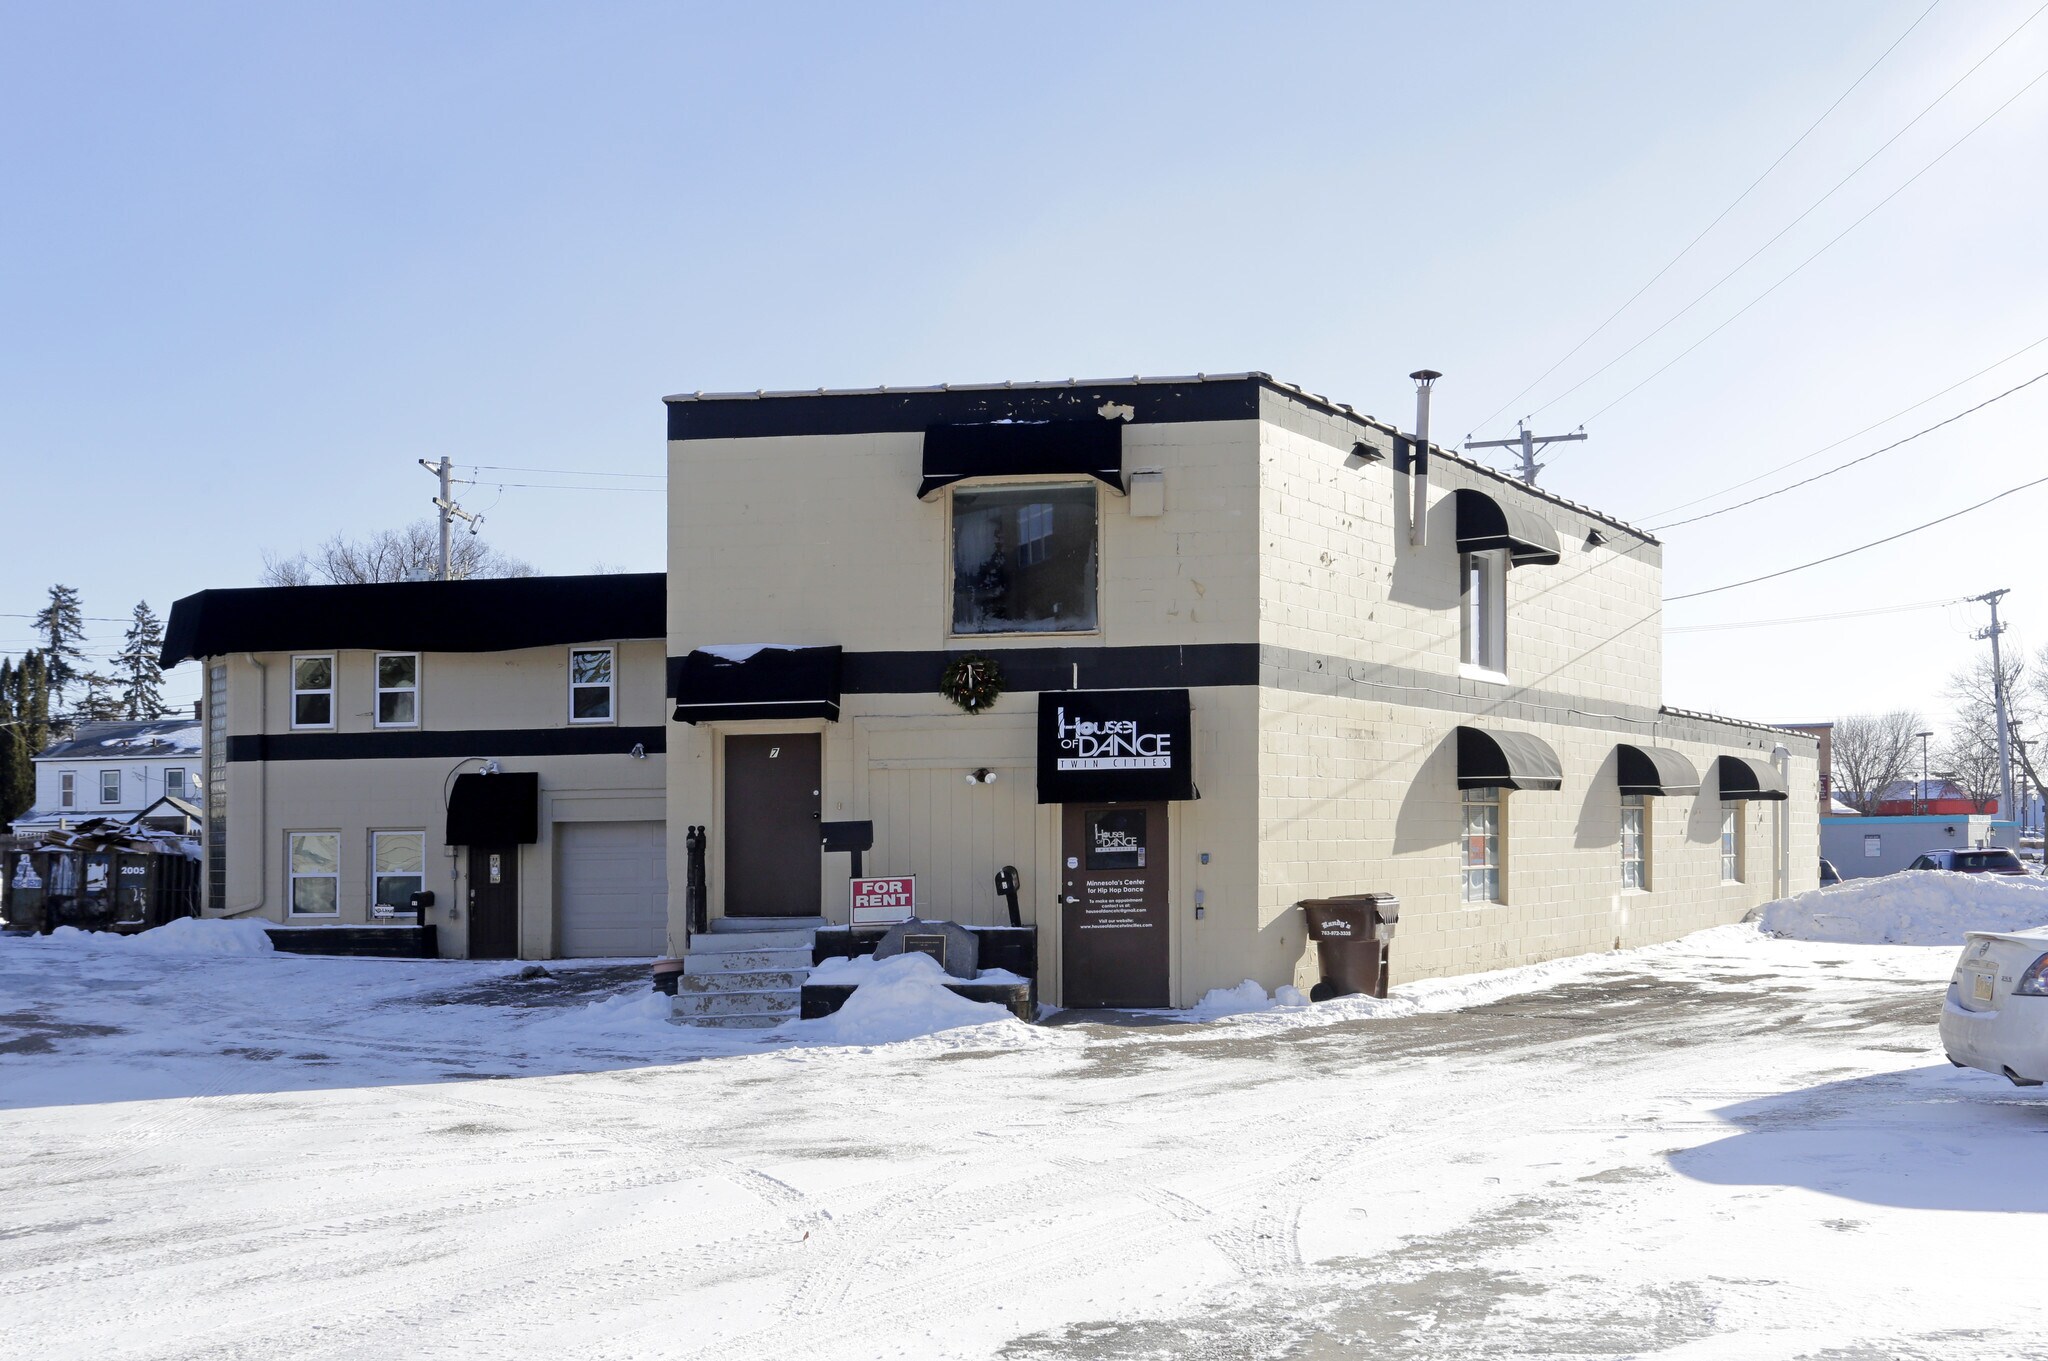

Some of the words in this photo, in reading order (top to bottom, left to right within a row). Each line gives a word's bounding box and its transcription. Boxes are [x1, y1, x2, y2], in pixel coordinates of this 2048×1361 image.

[1057, 707, 1134, 739] House
[1061, 739, 1078, 749] OF
[1078, 721, 1171, 757] DANCE
[770, 748, 779, 758] 7
[1061, 760, 1098, 768] TWIN
[1113, 758, 1167, 767] CITIES
[1102, 832, 1137, 847] DANCE
[121, 866, 145, 875] 2005
[862, 881, 903, 894] FOR
[855, 893, 910, 907] RENT
